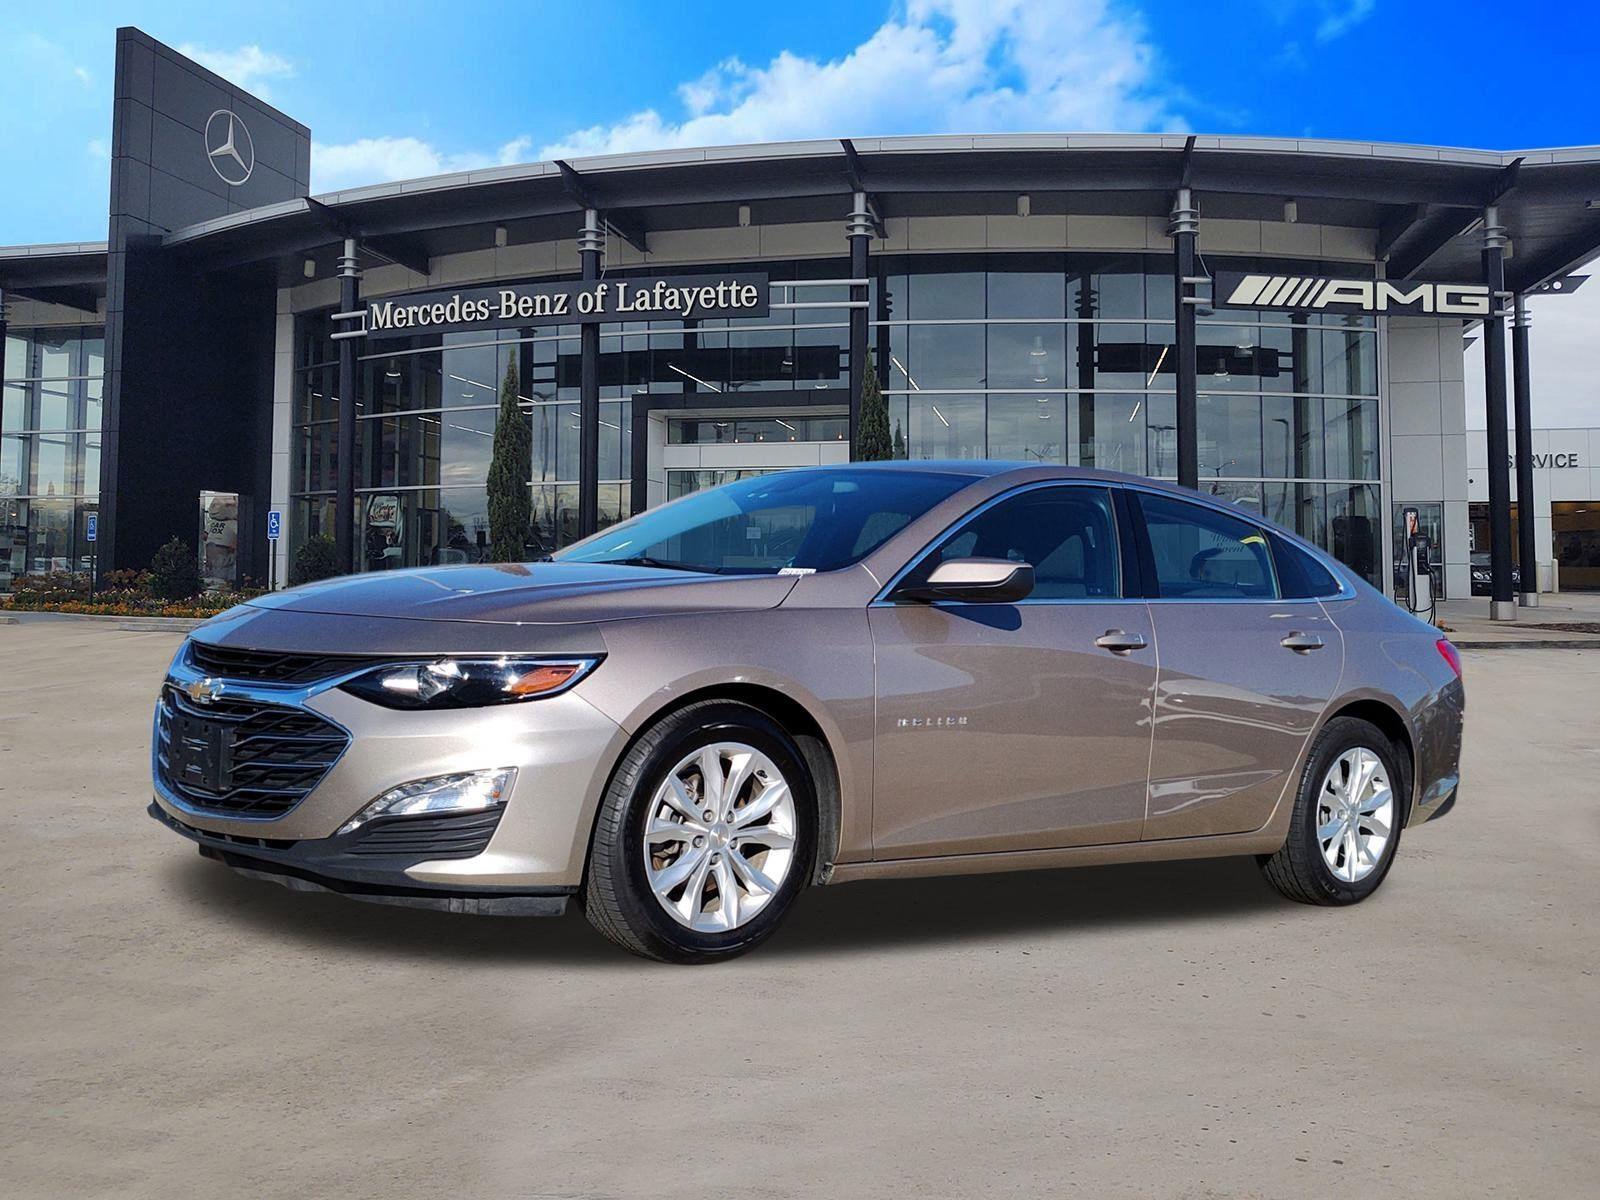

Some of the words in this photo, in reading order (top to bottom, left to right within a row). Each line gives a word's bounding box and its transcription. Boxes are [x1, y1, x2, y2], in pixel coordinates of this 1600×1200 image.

[370, 290, 569, 330] Mercedes-Benz
[577, 283, 608, 314] of
[615, 280, 758, 317] Lafayette
[1312, 279, 1490, 315] AMG
[1507, 453, 1578, 469] SRVICE
